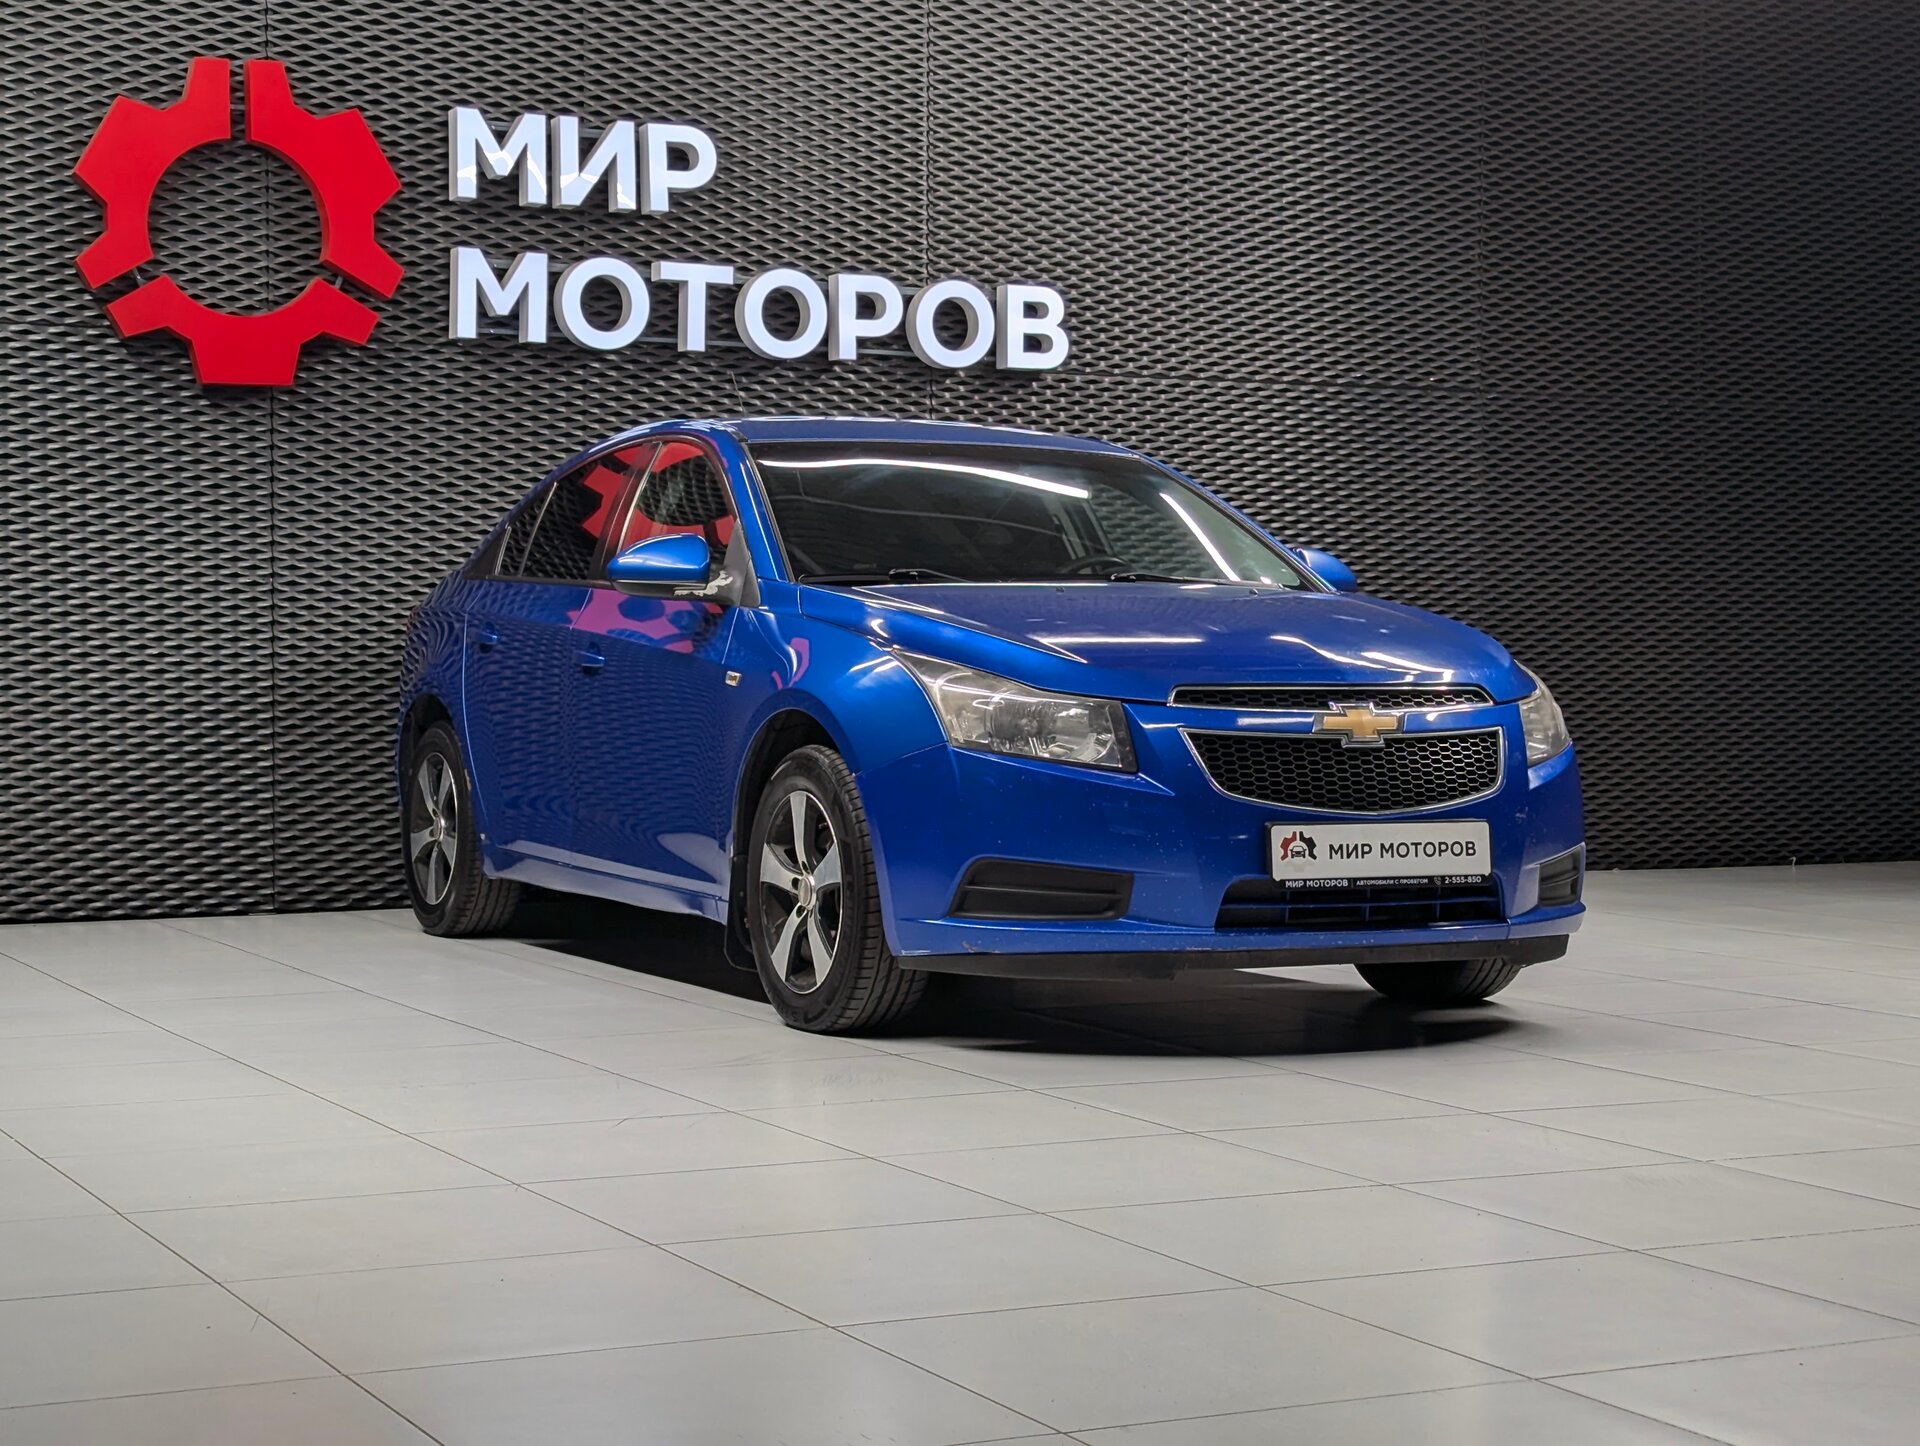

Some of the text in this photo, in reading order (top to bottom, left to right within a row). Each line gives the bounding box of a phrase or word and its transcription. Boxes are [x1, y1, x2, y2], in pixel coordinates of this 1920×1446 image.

[448, 106, 718, 215] МИР
[448, 246, 1071, 371] МОТОРОВ
[1285, 880, 1304, 888] МИР
[1306, 879, 1349, 888] МОТОРОВ
[1444, 875, 1482, 884] 2-555-850
[1328, 841, 1477, 860] МИР МОТОРОВ
